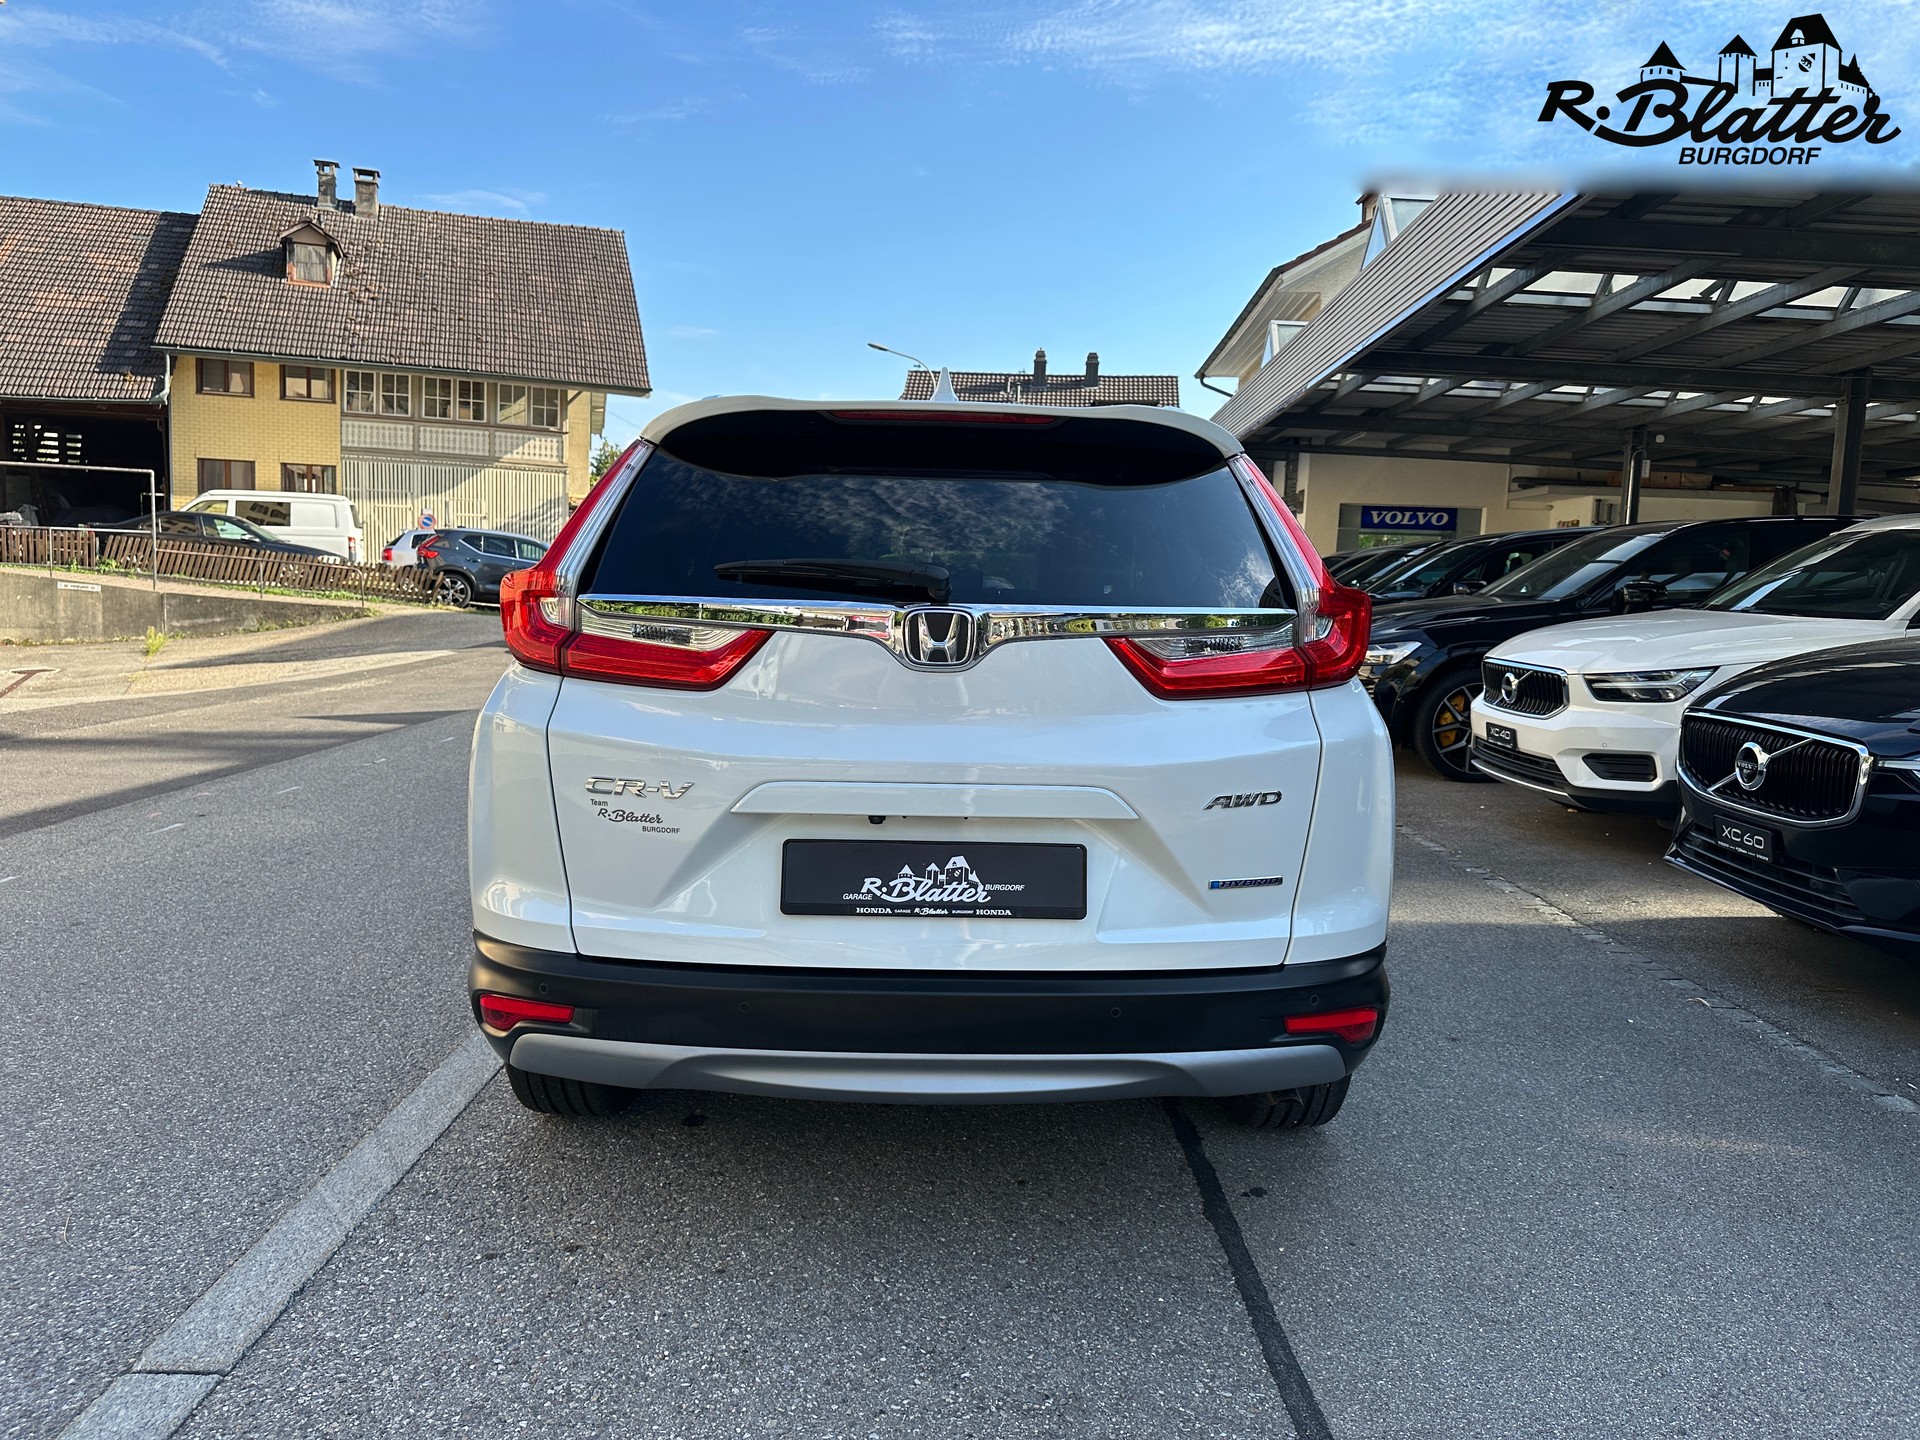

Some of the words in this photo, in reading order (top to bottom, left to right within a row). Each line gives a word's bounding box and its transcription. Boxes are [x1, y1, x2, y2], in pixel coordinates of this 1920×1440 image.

[1370, 510, 1449, 526] VOLVO
[584, 776, 695, 800] CR-V
[590, 799, 608, 807] Team
[1203, 790, 1282, 810] AWD
[641, 826, 680, 834] BURGDORF
[842, 893, 873, 901] GARAGE
[984, 883, 1026, 892] BURGDORF
